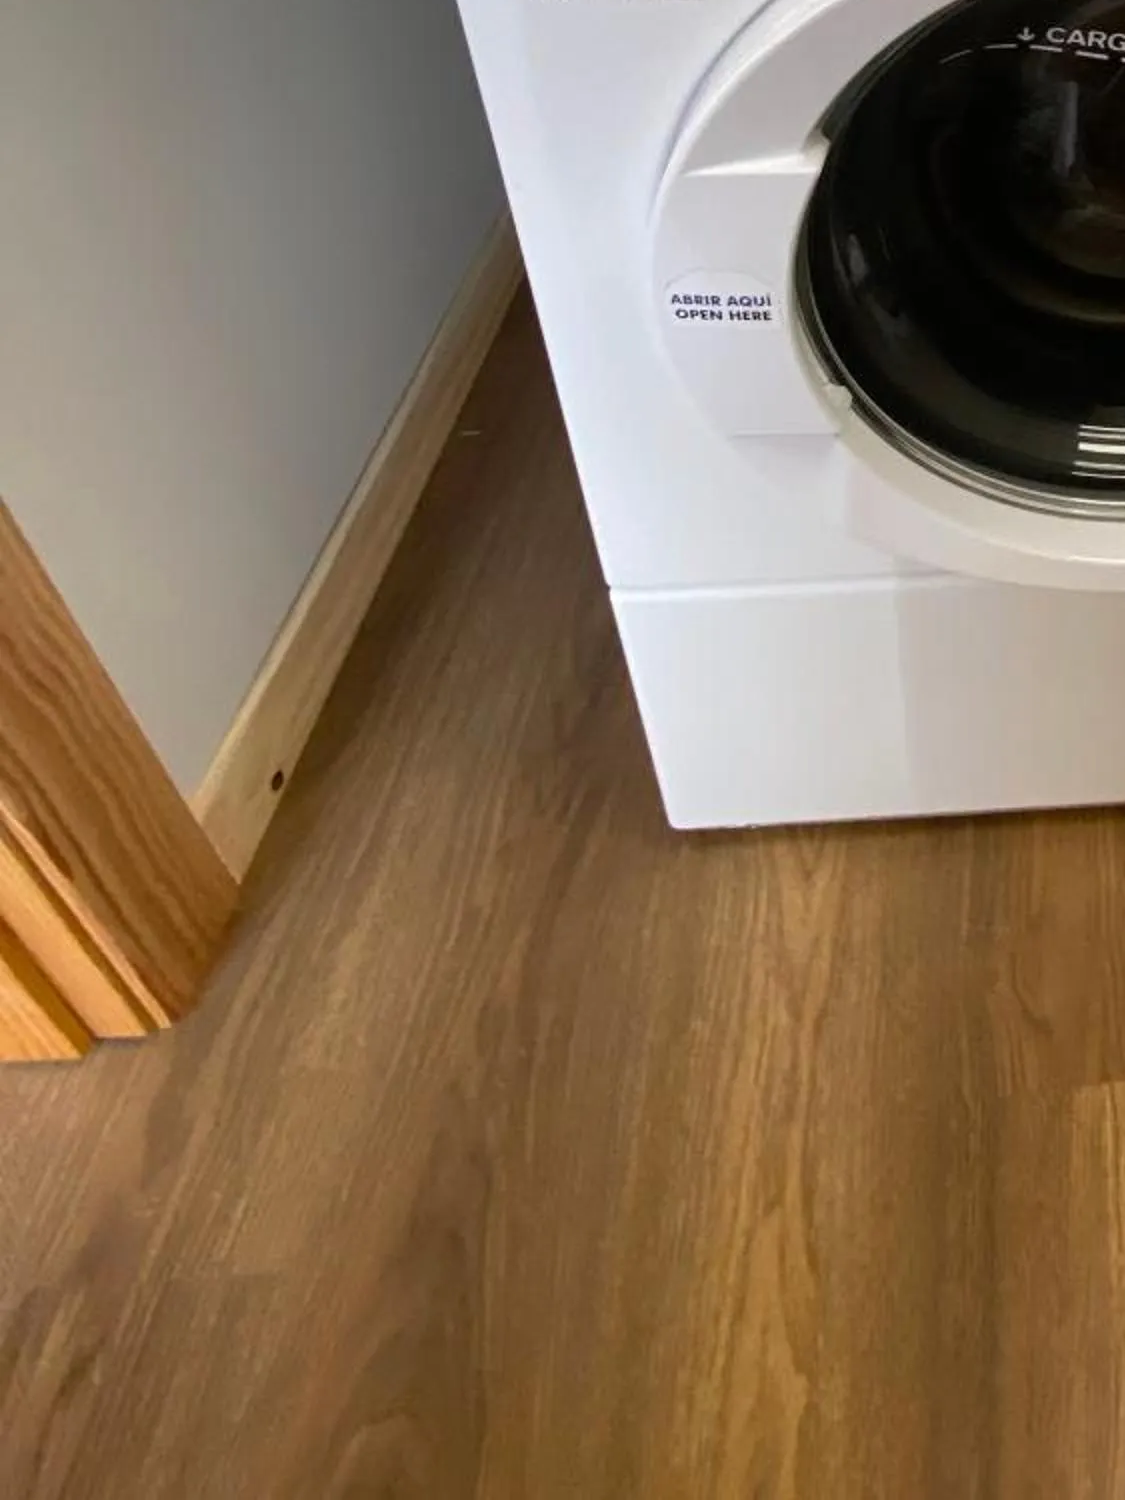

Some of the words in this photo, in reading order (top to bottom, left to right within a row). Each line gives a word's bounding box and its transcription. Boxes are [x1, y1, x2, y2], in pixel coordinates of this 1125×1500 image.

[671, 293, 722, 306] ABRIR
[675, 309, 723, 321] OPEN
[729, 309, 772, 321] HERE
